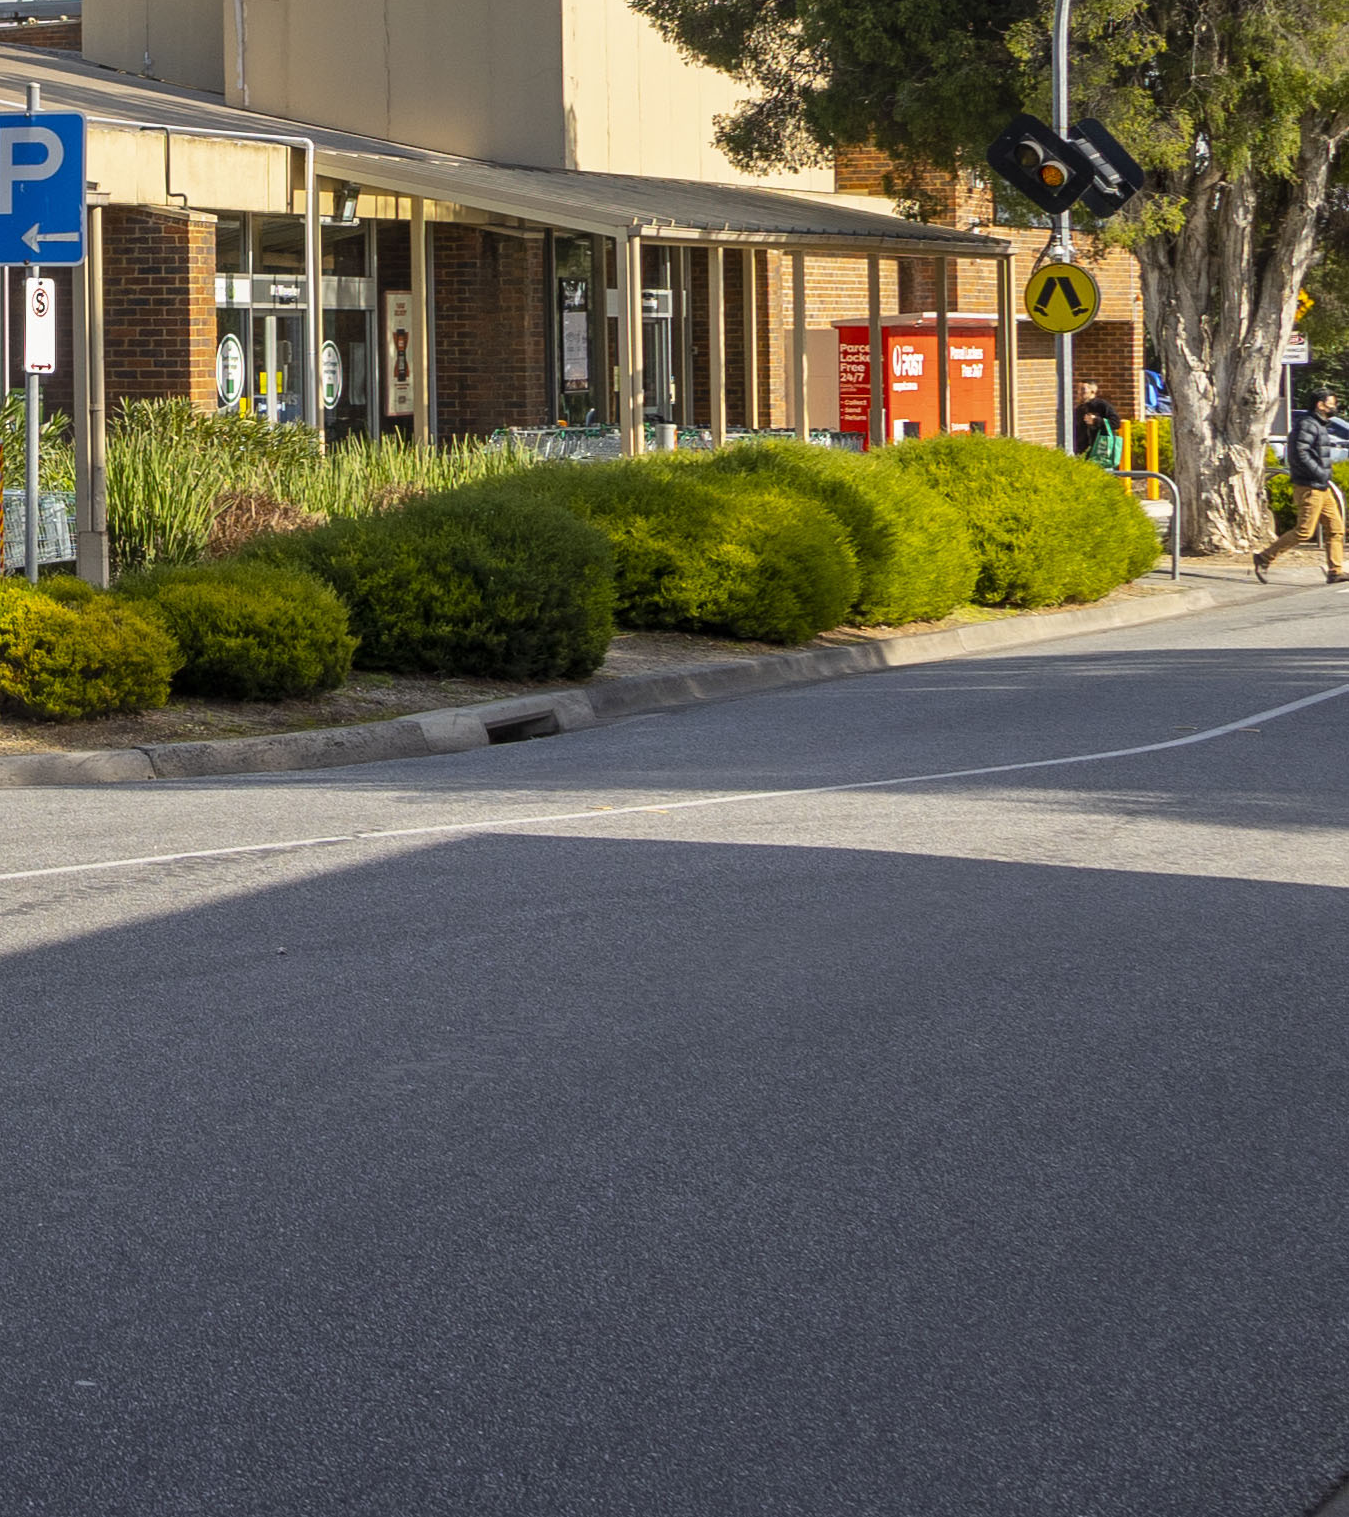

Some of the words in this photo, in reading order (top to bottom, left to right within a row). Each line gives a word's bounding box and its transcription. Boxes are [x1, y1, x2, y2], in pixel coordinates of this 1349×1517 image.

[840, 344, 871, 353] Parce
[840, 363, 866, 372] Free
[840, 372, 865, 382] 24/7
